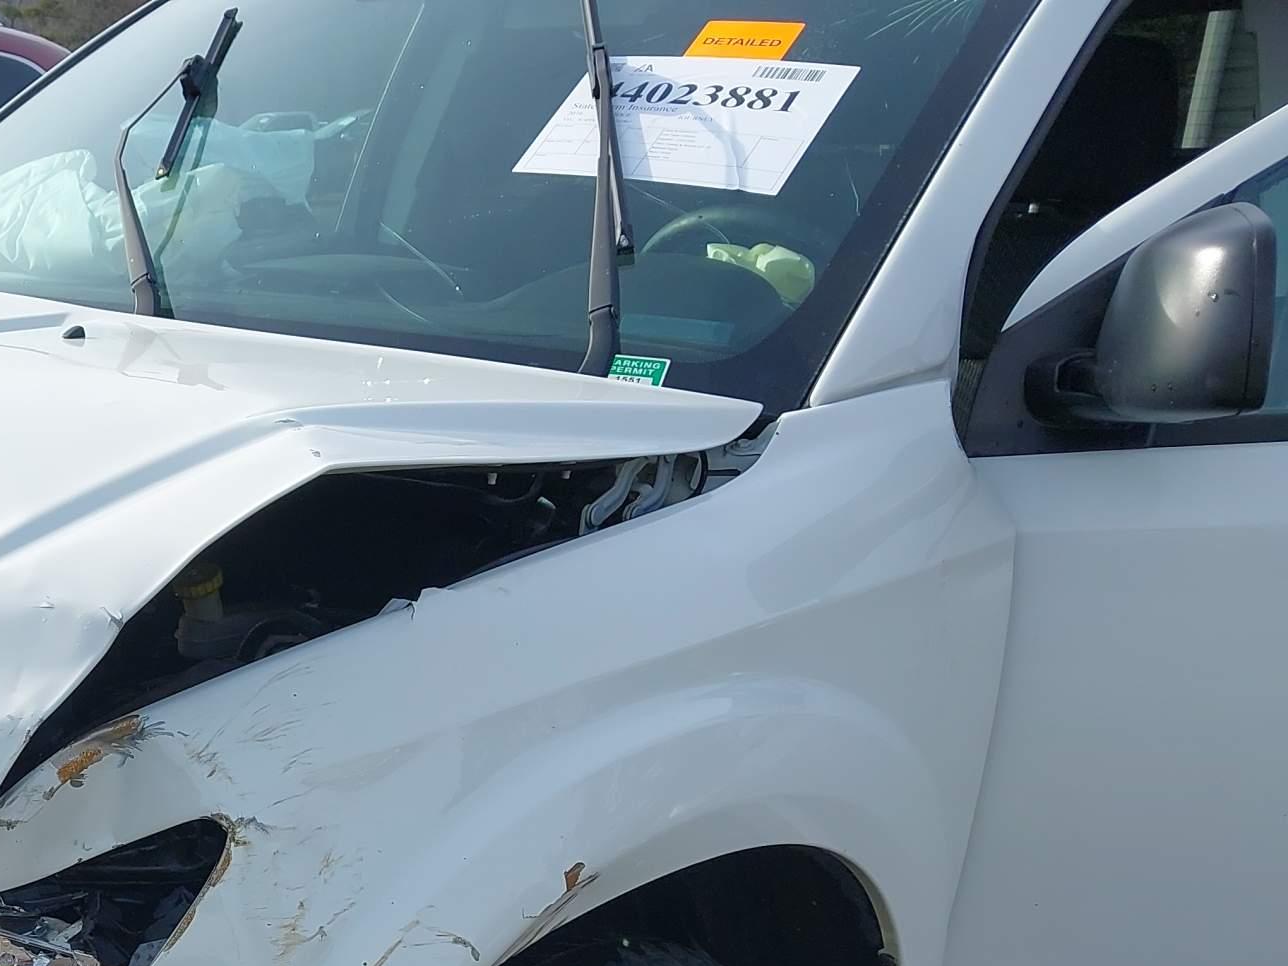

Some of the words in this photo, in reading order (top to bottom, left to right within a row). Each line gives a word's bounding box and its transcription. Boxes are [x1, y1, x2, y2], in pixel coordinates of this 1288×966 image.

[703, 37, 782, 47] DETAILED
[628, 104, 678, 113] Insurance
[613, 359, 661, 369] ARKING
